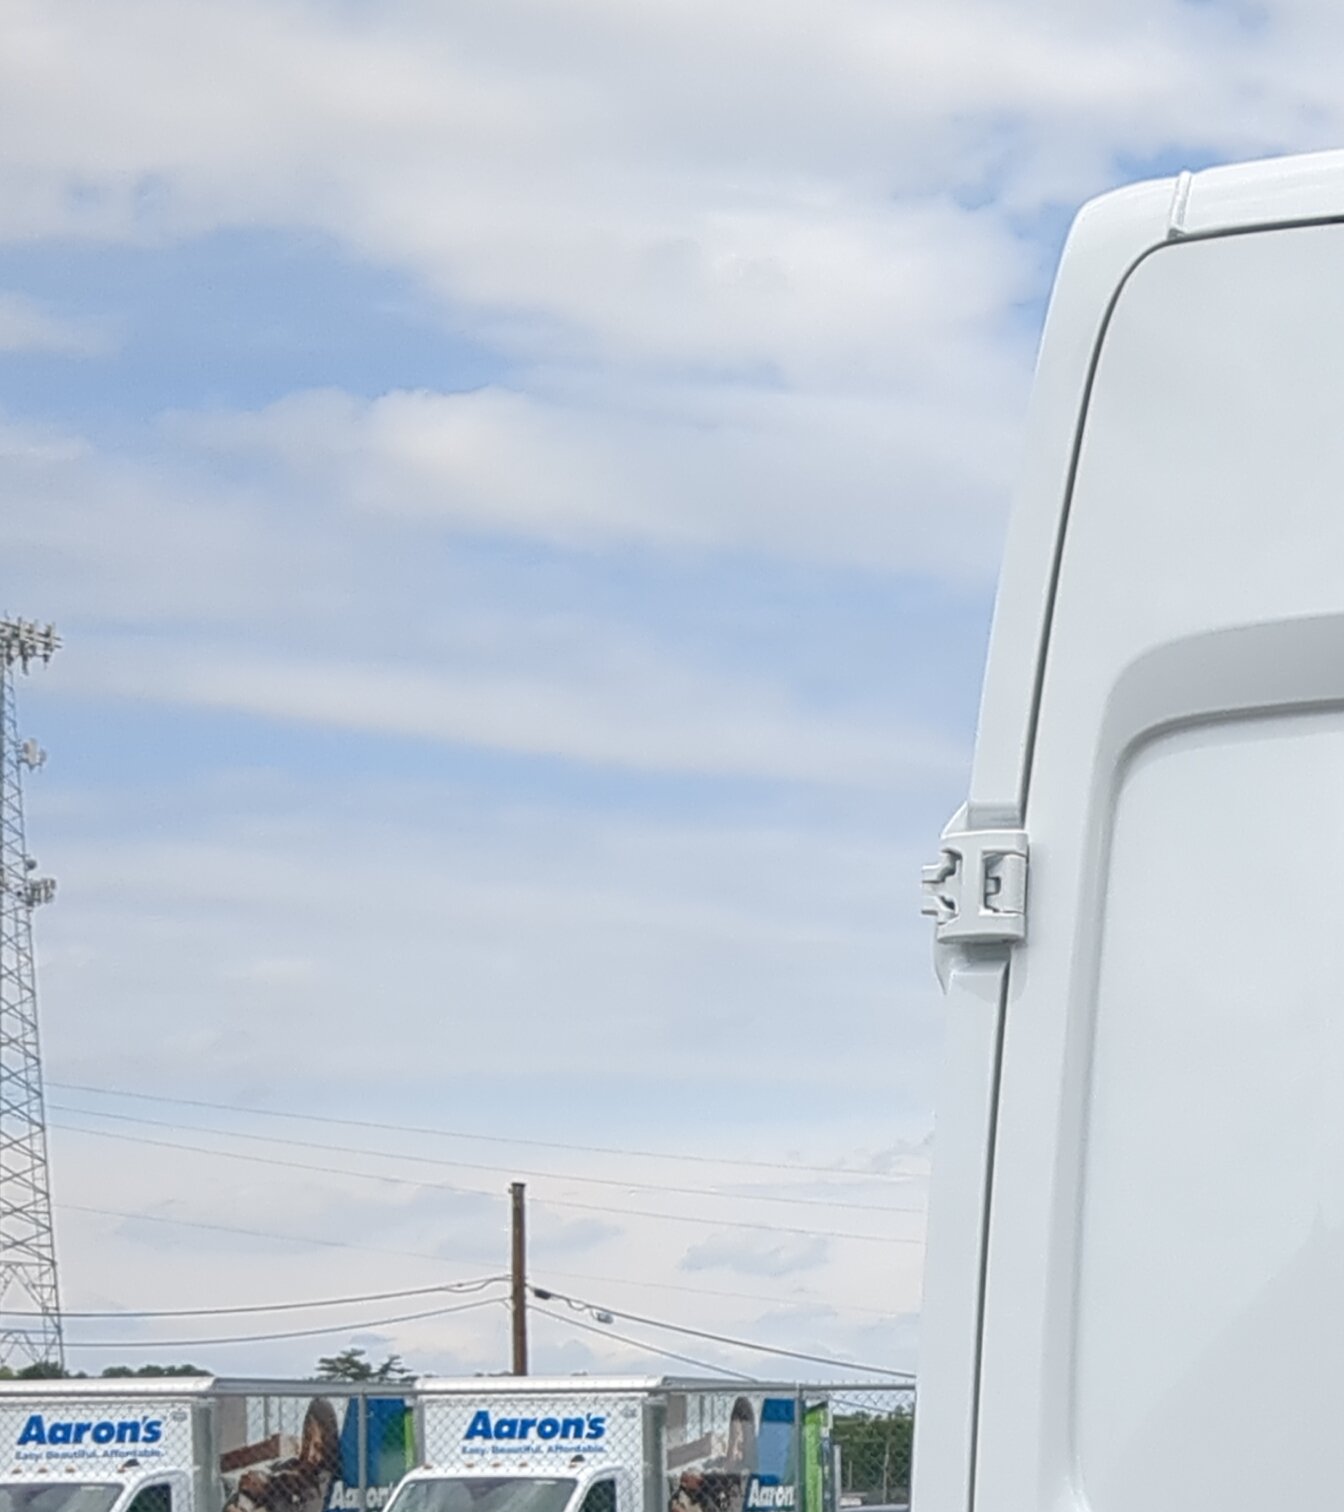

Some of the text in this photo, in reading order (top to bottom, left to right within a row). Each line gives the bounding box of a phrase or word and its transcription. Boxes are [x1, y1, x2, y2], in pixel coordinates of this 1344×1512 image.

[17, 1414, 163, 1445] Aaron's
[464, 1409, 607, 1441] Aaron's
[747, 1478, 795, 1508] Aaron
